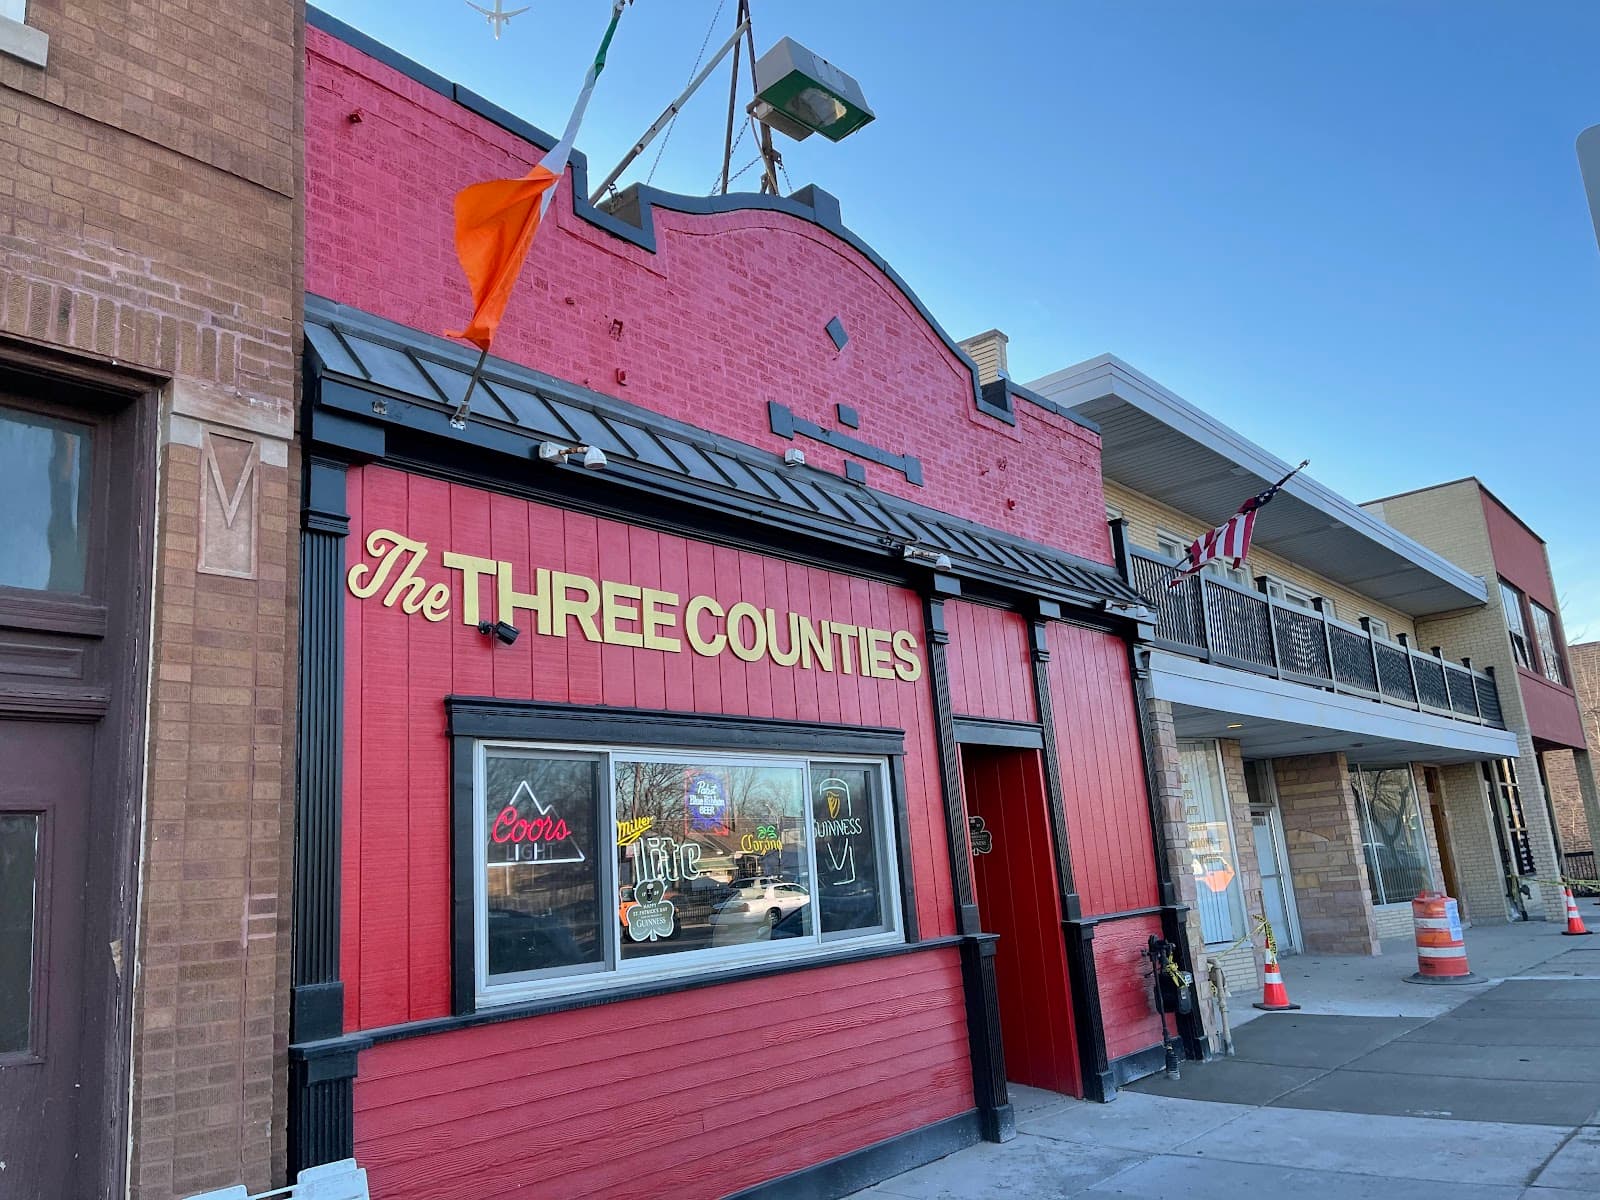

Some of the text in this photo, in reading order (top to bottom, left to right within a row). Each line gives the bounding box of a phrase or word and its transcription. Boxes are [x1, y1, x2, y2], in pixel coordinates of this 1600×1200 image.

[348, 529, 922, 682] The THREE COUNTIES
[697, 780, 718, 795] Pabst
[699, 805, 715, 815] BEER
[492, 806, 571, 842] Coors
[616, 815, 655, 842] Miller
[506, 842, 556, 861] LIGHT
[741, 834, 783, 854] Corona
[633, 836, 702, 883] lite
[636, 917, 666, 928] GUINNESS
